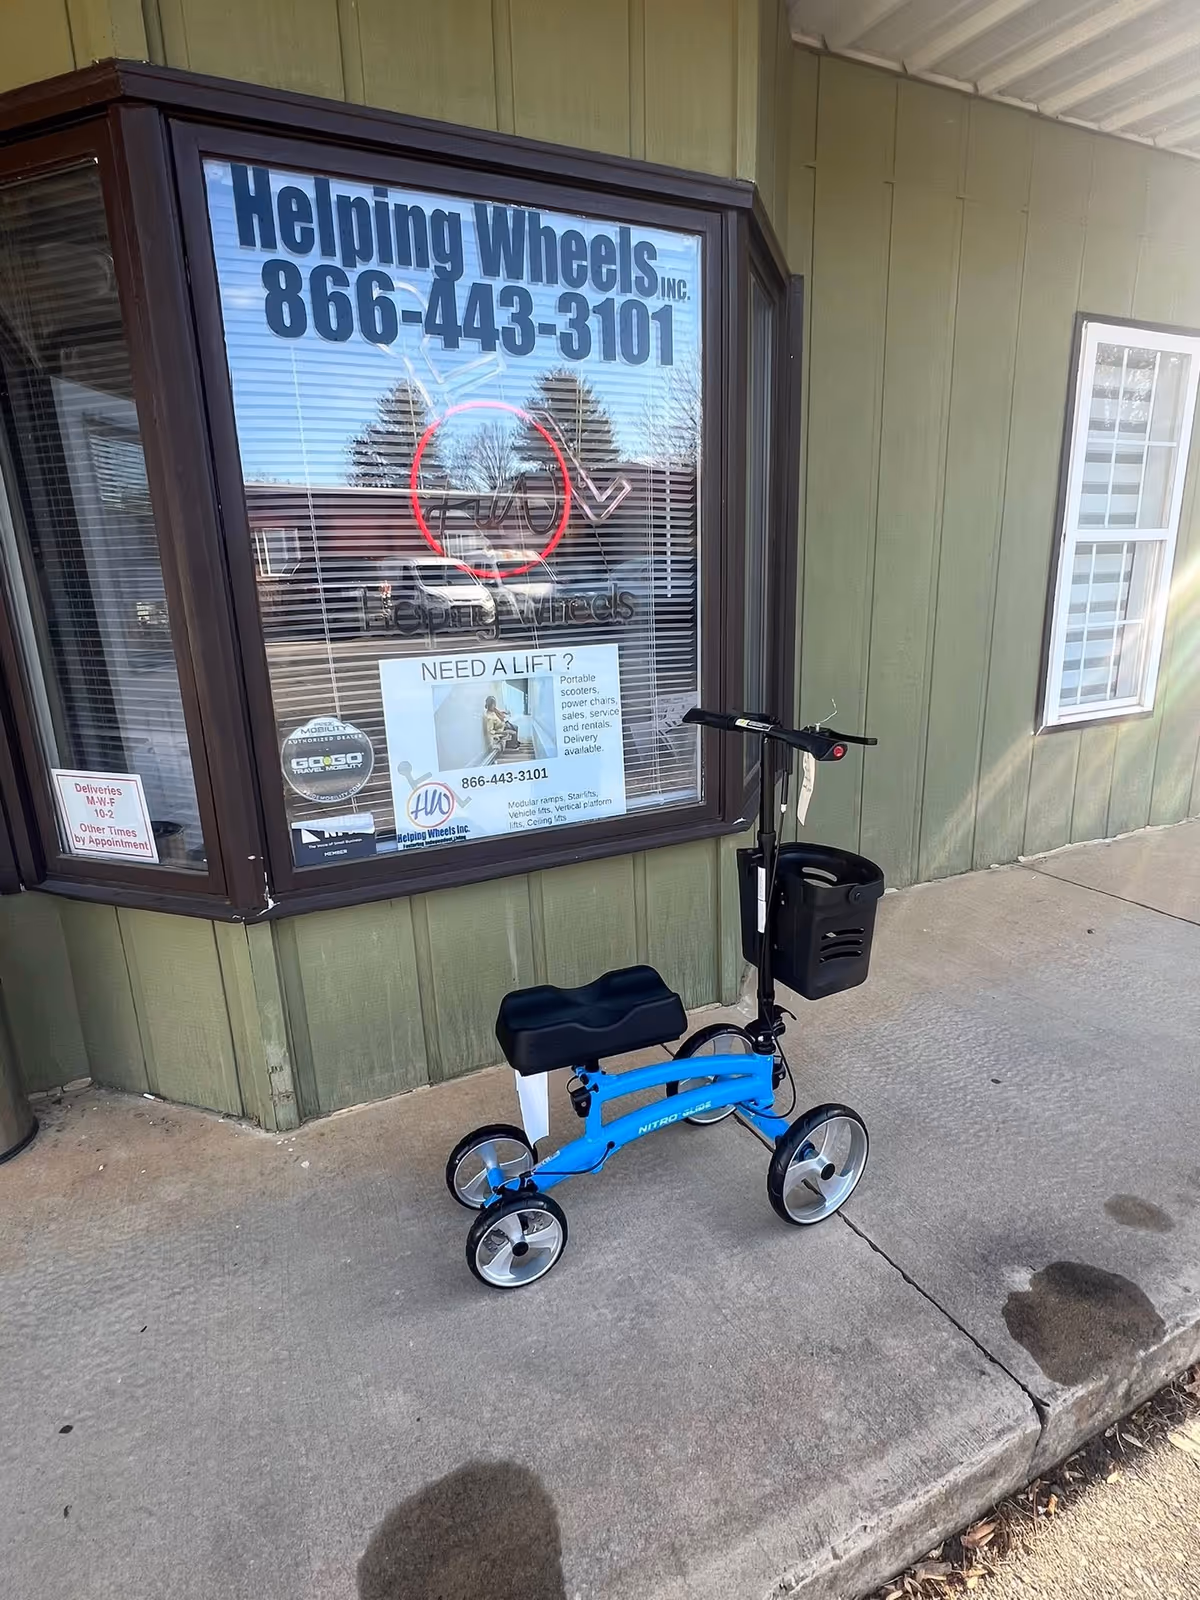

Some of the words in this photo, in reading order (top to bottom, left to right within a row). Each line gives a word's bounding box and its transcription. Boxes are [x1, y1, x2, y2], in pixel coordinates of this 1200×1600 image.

[230, 162, 464, 282] Helping
[474, 202, 659, 299] Wheels
[661, 276, 691, 301] INC.
[261, 259, 674, 367] 866-443-3101
[422, 659, 487, 681] NEED
[492, 657, 508, 676] A
[513, 654, 557, 674] LIFT
[560, 674, 596, 684] Portable
[560, 687, 600, 697] scooters,
[561, 700, 588, 710] power
[590, 696, 618, 706] chairs,
[562, 711, 588, 721] sales,
[590, 708, 620, 718] service
[300, 726, 347, 735] MOBILITY
[563, 723, 579, 733] and
[582, 720, 613, 730] rentals.
[288, 736, 334, 745] AUTHORIZED
[563, 734, 598, 744] Delivery
[564, 745, 605, 756] available.
[292, 767, 324, 775] TRAVEL
[326, 763, 363, 771] MOBILITY
[461, 767, 549, 789] 866-443-3101
[74, 782, 123, 796] Deliveries
[86, 796, 116, 807] M-W-F
[508, 799, 539, 809] Modular
[540, 796, 566, 805] ramps,
[94, 808, 115, 819] 10-2
[508, 808, 537, 819] Vehicle
[554, 802, 582, 812] Vertical
[583, 798, 612, 809] platform
[79, 822, 106, 834] Other
[107, 826, 137, 837] Times
[509, 820, 525, 830] lifts,
[527, 816, 553, 827] Ceiling
[397, 831, 427, 844] Helping
[428, 826, 456, 839] Wheels
[456, 824, 471, 834] Inc.
[74, 834, 85, 846] by
[89, 835, 149, 851] Appointment
[638, 1113, 678, 1134] NITRO
[682, 1100, 712, 1117] GLIDE
